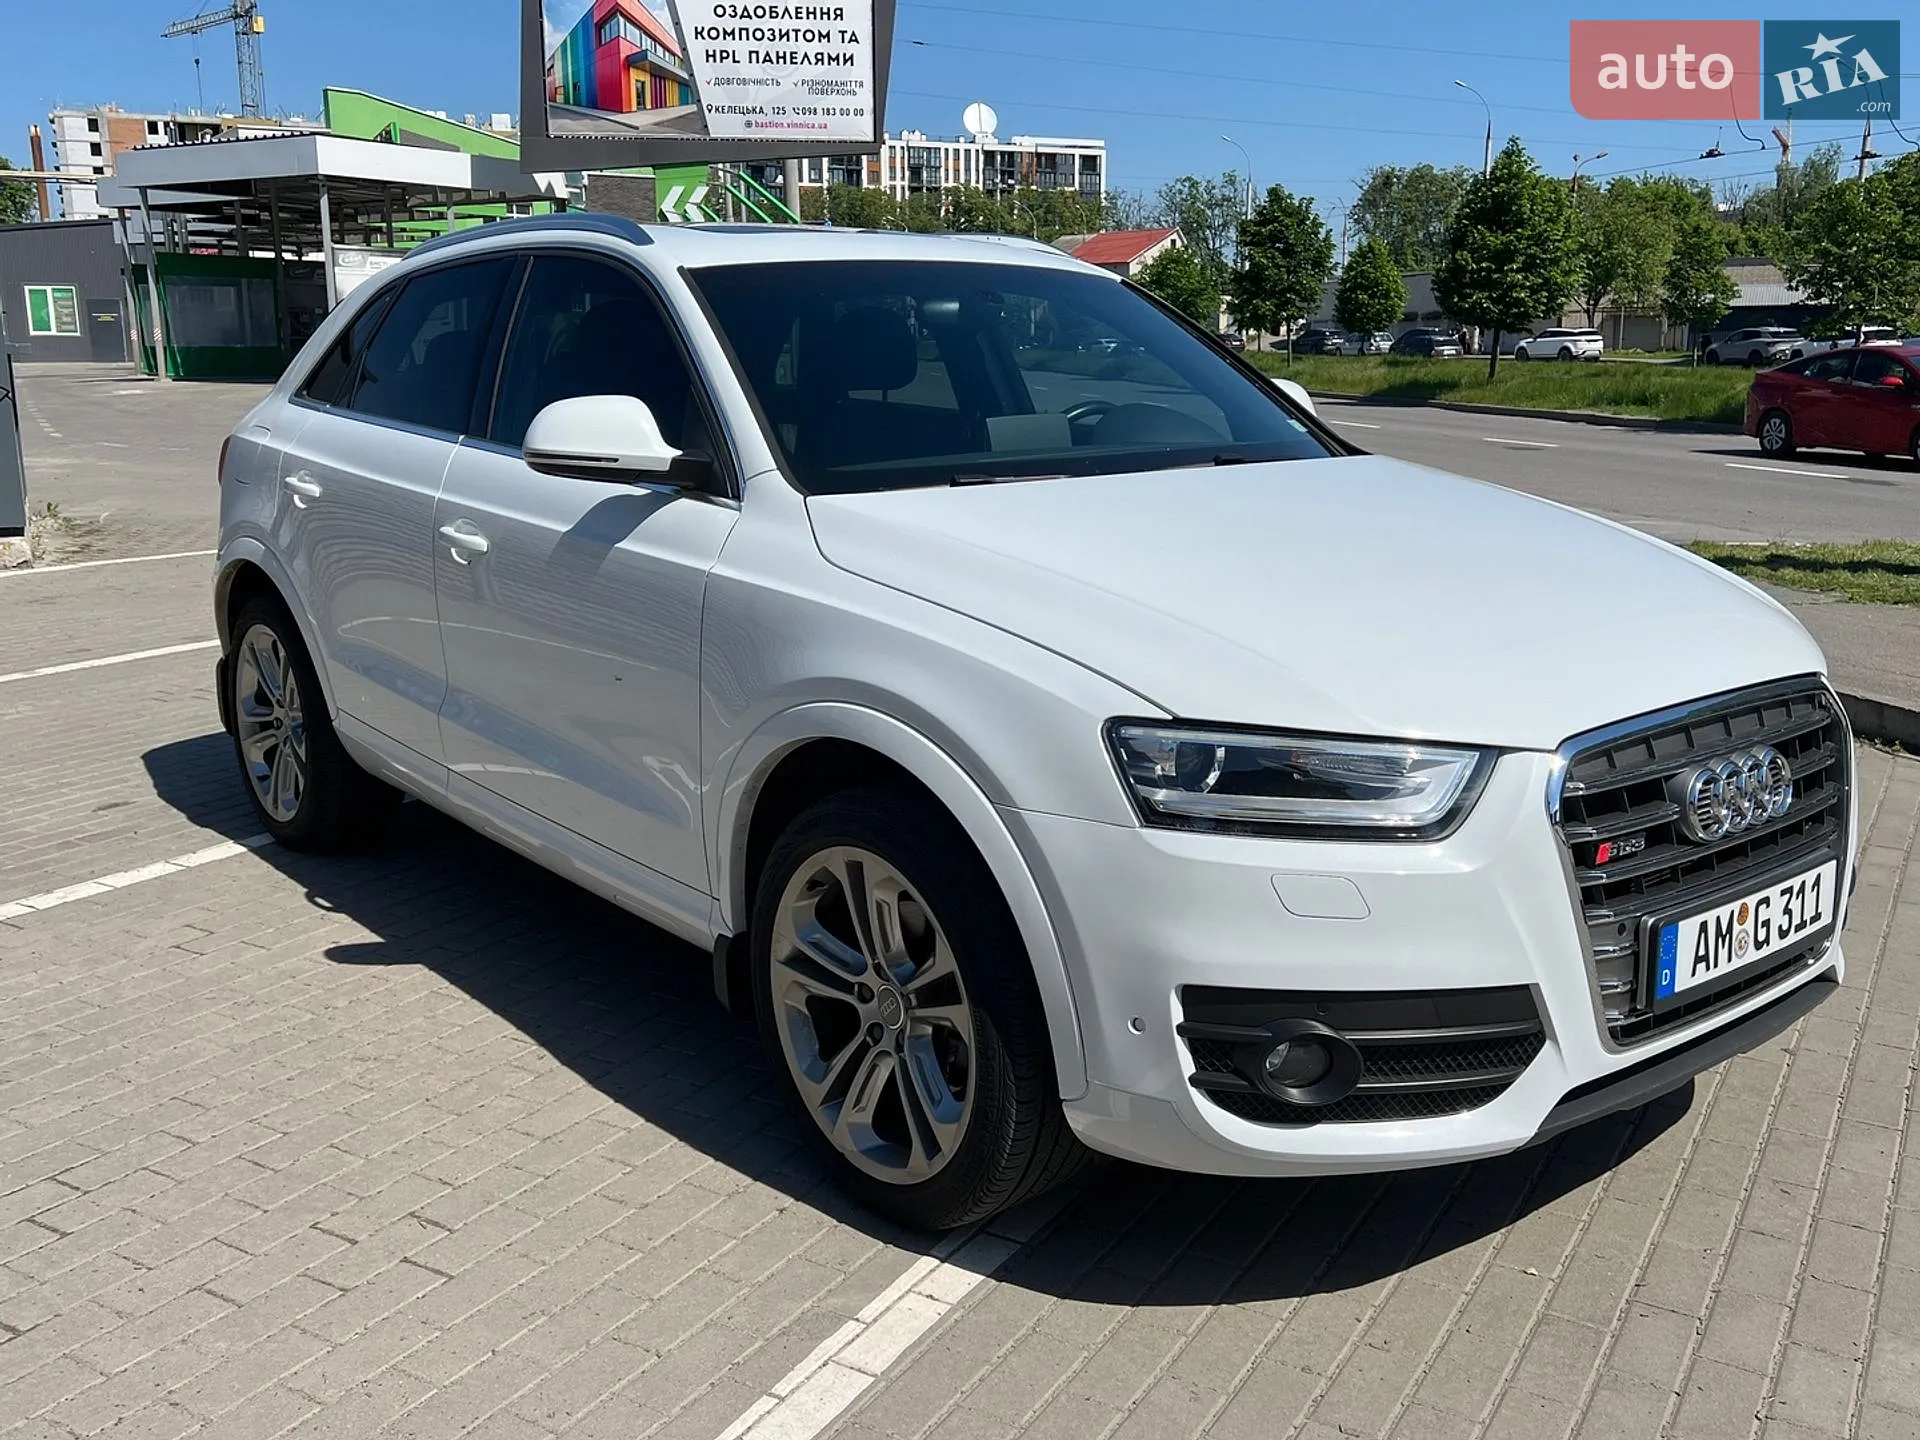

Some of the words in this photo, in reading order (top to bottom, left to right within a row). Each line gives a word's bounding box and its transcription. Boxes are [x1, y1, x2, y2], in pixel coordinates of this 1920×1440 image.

[713, 4, 844, 21] ОЗДОБЛЕННЯ
[694, 26, 831, 43] КОМПОЗИТОМ
[838, 29, 860, 44] ТА
[705, 49, 740, 63] HPL
[748, 50, 854, 67] ПАНЕЛЯМИ
[714, 77, 781, 87] ДОВГОВІЧНІСТЬ
[801, 79, 864, 88] РІЗНОМАНІТТЯ
[808, 87, 857, 96] ПОВЕРХОНЬ
[714, 105, 768, 116] КЕЛЕЦЬКА,
[771, 106, 787, 115] 125
[801, 106, 818, 116] 098
[821, 107, 836, 116] 183
[839, 108, 851, 116] 00
[853, 108, 864, 117] 00
[754, 120, 828, 130] bastion.vinnica.ua
[1691, 909, 1733, 978] AM
[1753, 895, 1771, 951] G
[1778, 872, 1823, 939] 311
[1661, 968, 1671, 986] D
